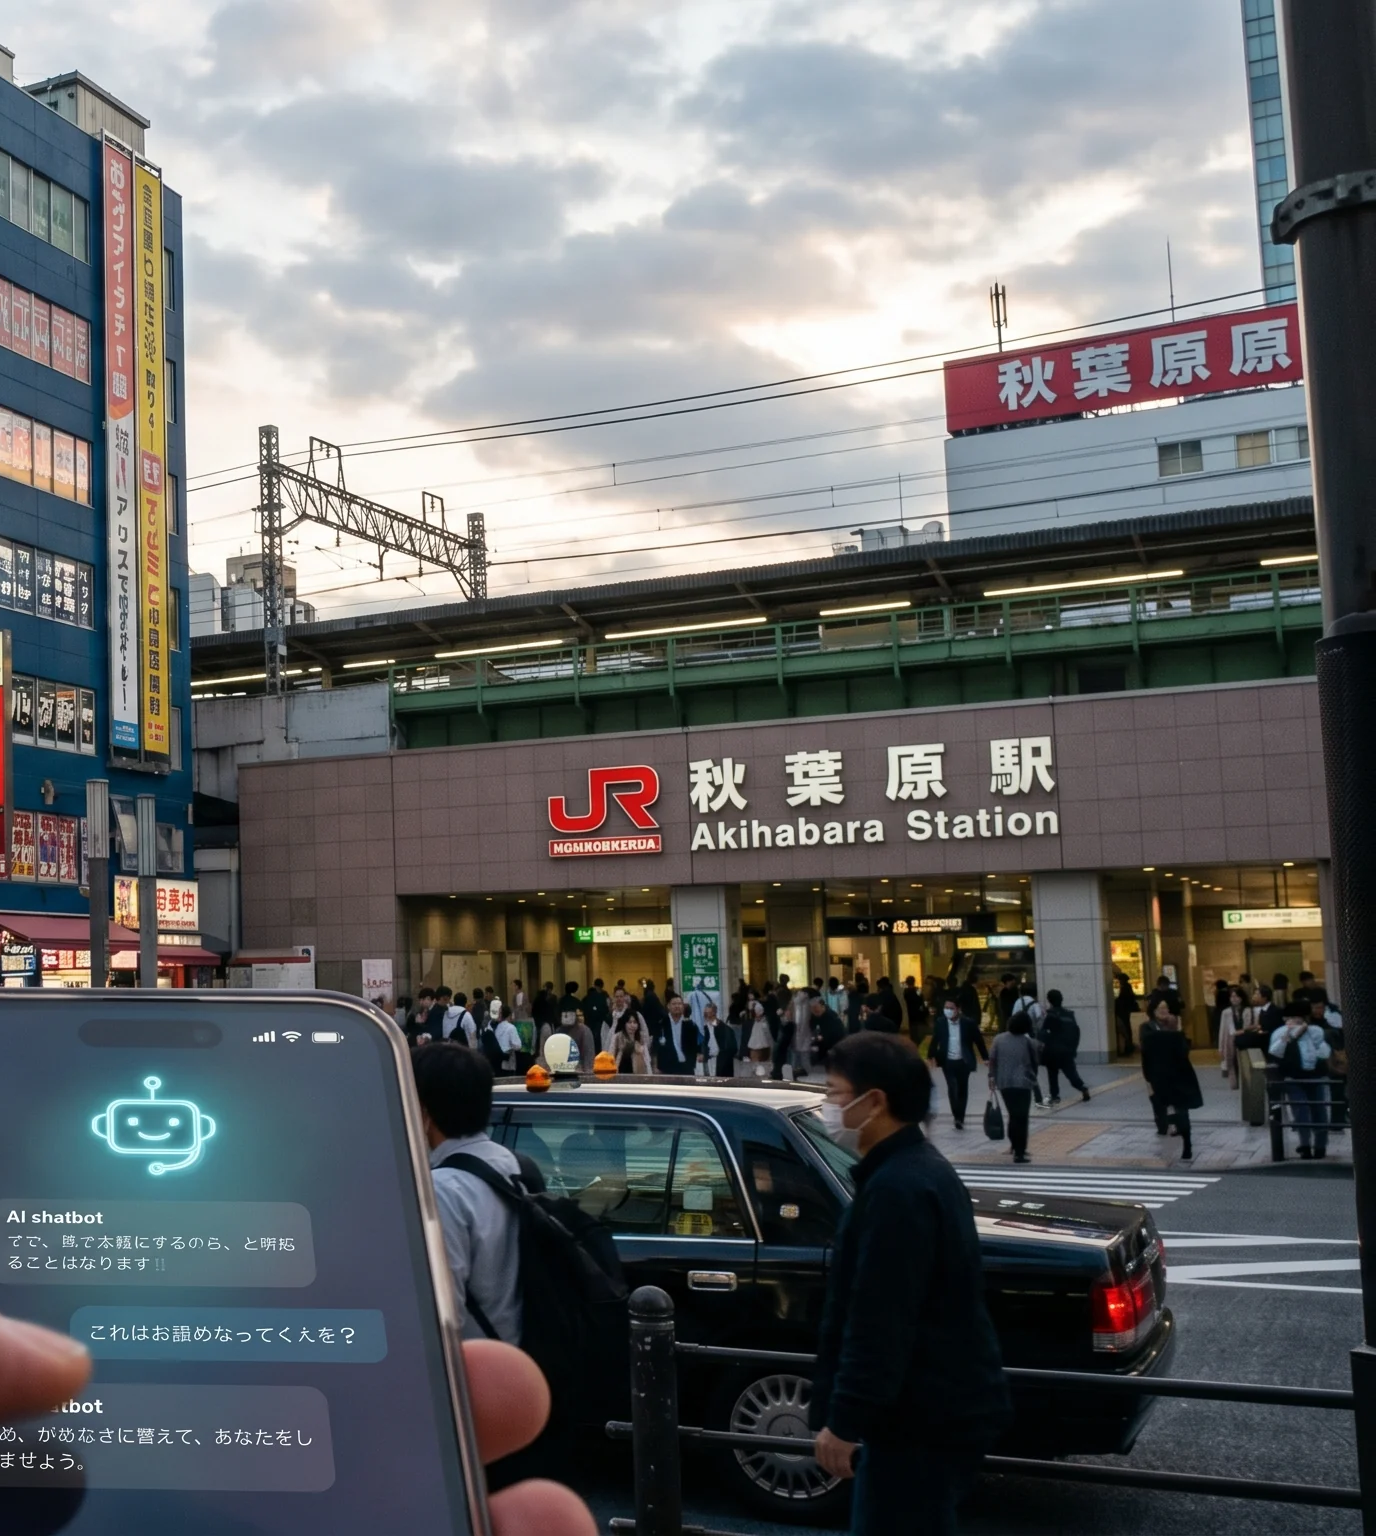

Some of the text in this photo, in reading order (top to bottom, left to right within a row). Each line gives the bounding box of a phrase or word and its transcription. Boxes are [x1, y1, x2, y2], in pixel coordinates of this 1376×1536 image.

[997, 317, 1293, 411] 秋葉原原
[548, 765, 660, 833] JR
[689, 735, 1056, 814] 秋葉原駅
[690, 806, 1060, 852] Akihabara Station
[7, 1210, 104, 1225] AI shatbot
